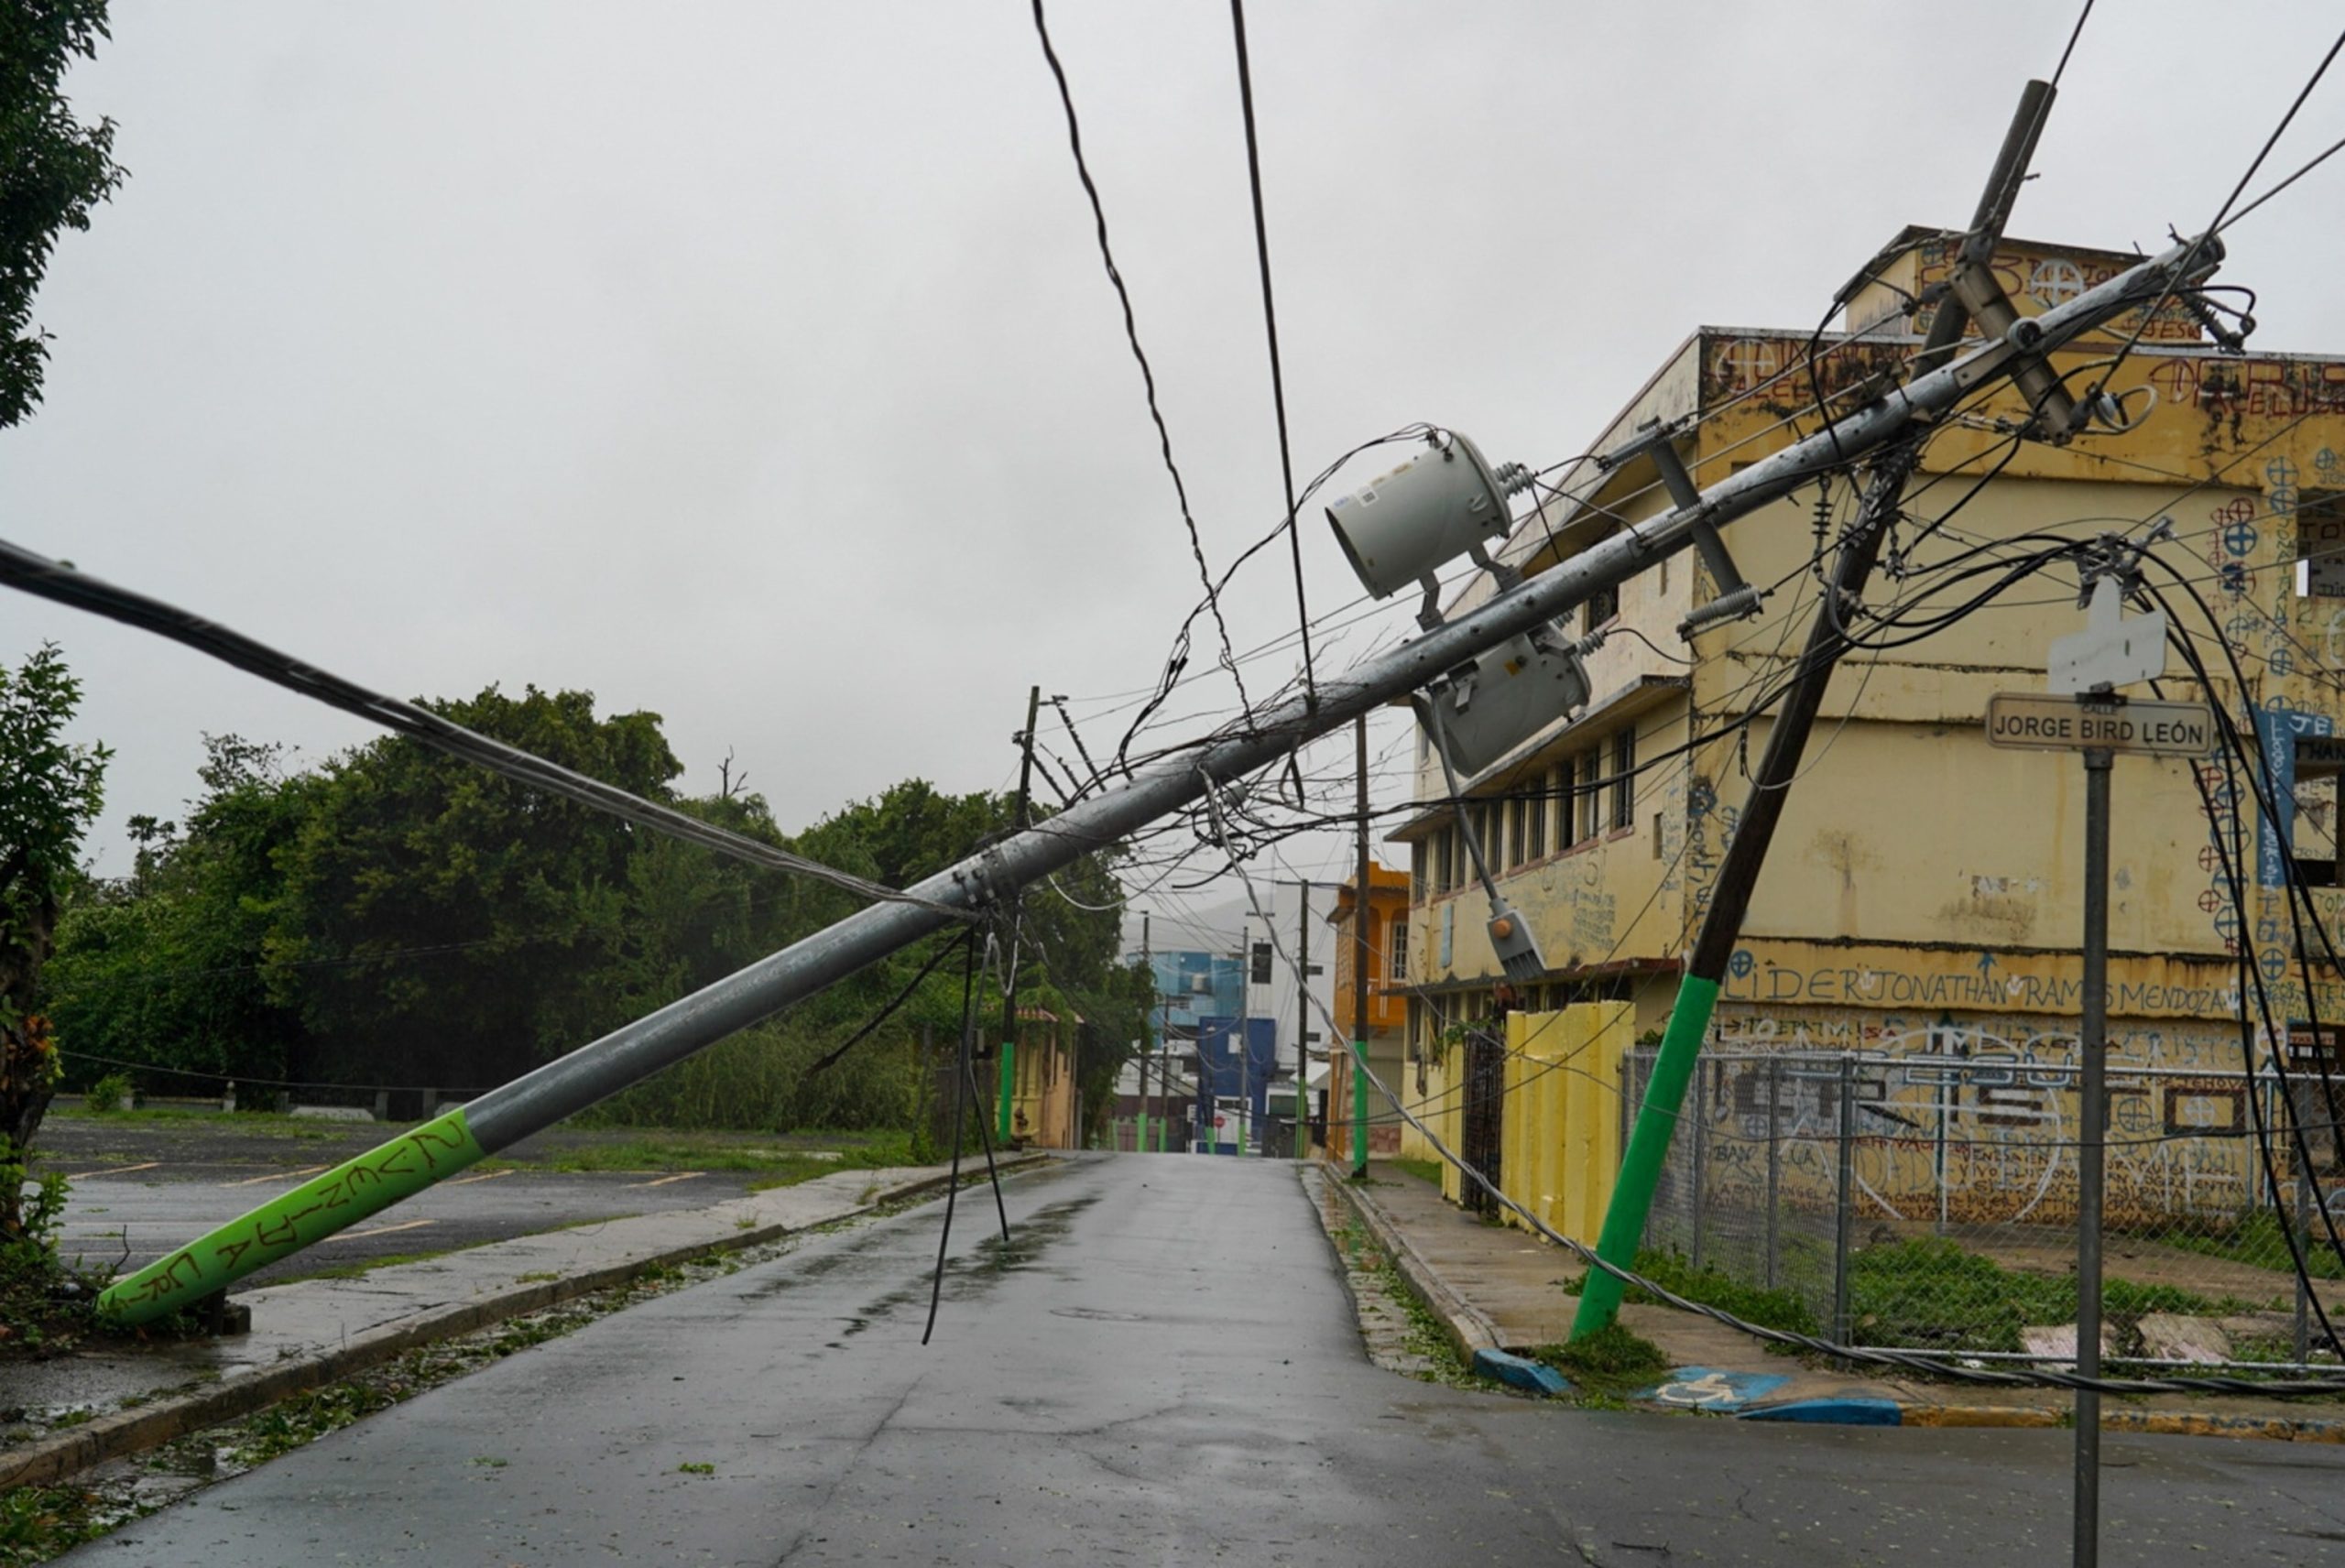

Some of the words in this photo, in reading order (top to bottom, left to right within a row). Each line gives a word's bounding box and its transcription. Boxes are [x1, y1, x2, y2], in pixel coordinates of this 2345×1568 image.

[1994, 715, 2072, 738] JORGE
[2080, 719, 2134, 742] BIRD
[2142, 719, 2203, 744] LEÓN
[1868, 971, 2007, 1006] JONATHAN
[2024, 976, 2113, 1008] RAMS
[2120, 983, 2224, 1014] MENDOZA
